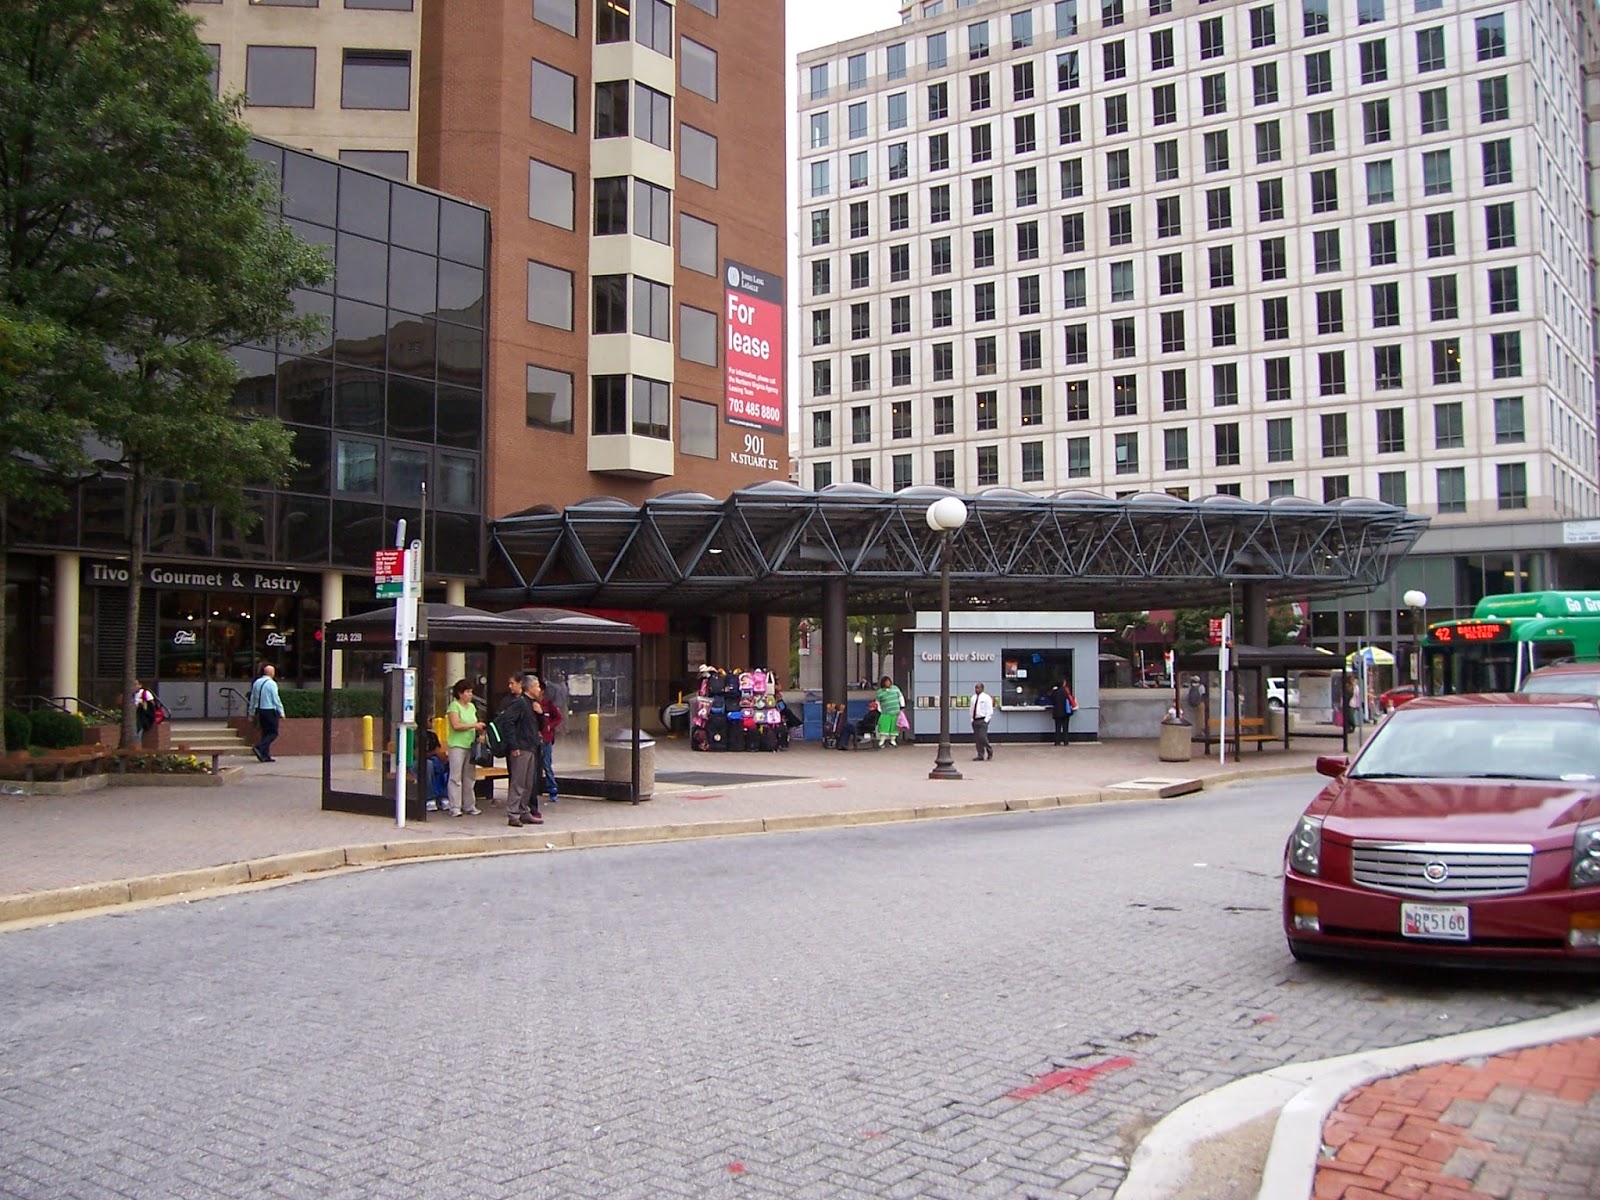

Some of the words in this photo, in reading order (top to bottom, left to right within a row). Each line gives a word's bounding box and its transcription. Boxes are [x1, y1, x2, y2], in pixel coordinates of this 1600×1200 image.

[728, 294, 755, 325] For
[728, 324, 770, 360] lease
[728, 397, 744, 414] 703
[745, 401, 760, 417] 485
[761, 405, 780, 422] 8800
[744, 434, 765, 456] 901
[738, 454, 768, 469] STUART
[92, 564, 143, 582] Tivo
[150, 568, 223, 586] Gourmet
[231, 572, 244, 588] &
[254, 574, 301, 593] Pastry
[1565, 597, 1582, 612] Go
[336, 633, 349, 642] 22A
[350, 633, 362, 642] 22B
[1435, 627, 1451, 641] 42
[1457, 624, 1500, 634] BALLSTON
[921, 651, 969, 662] Comuter
[970, 651, 996, 662] Store
